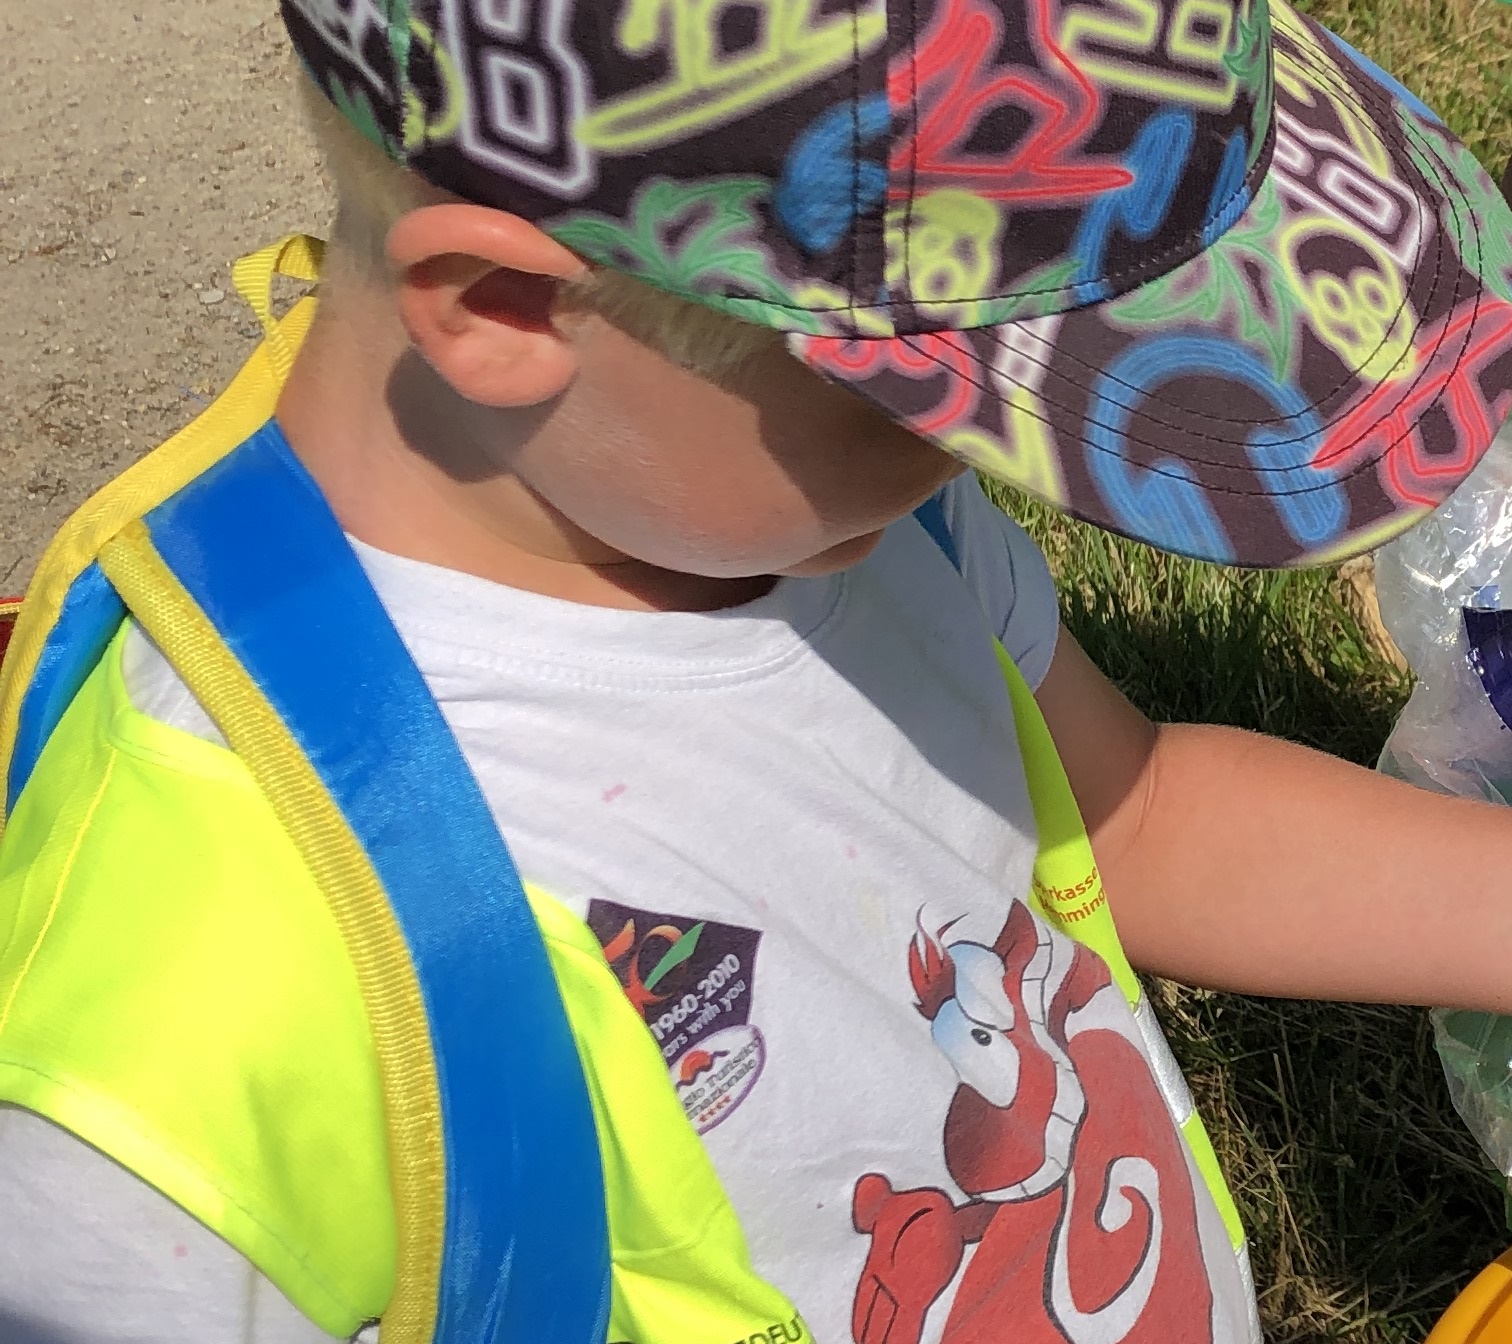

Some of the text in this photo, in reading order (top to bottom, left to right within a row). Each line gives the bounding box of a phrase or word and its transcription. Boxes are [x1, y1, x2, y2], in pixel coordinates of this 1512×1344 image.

[650, 953, 740, 1041] 1960-2010
[663, 978, 746, 1058] ars with you
